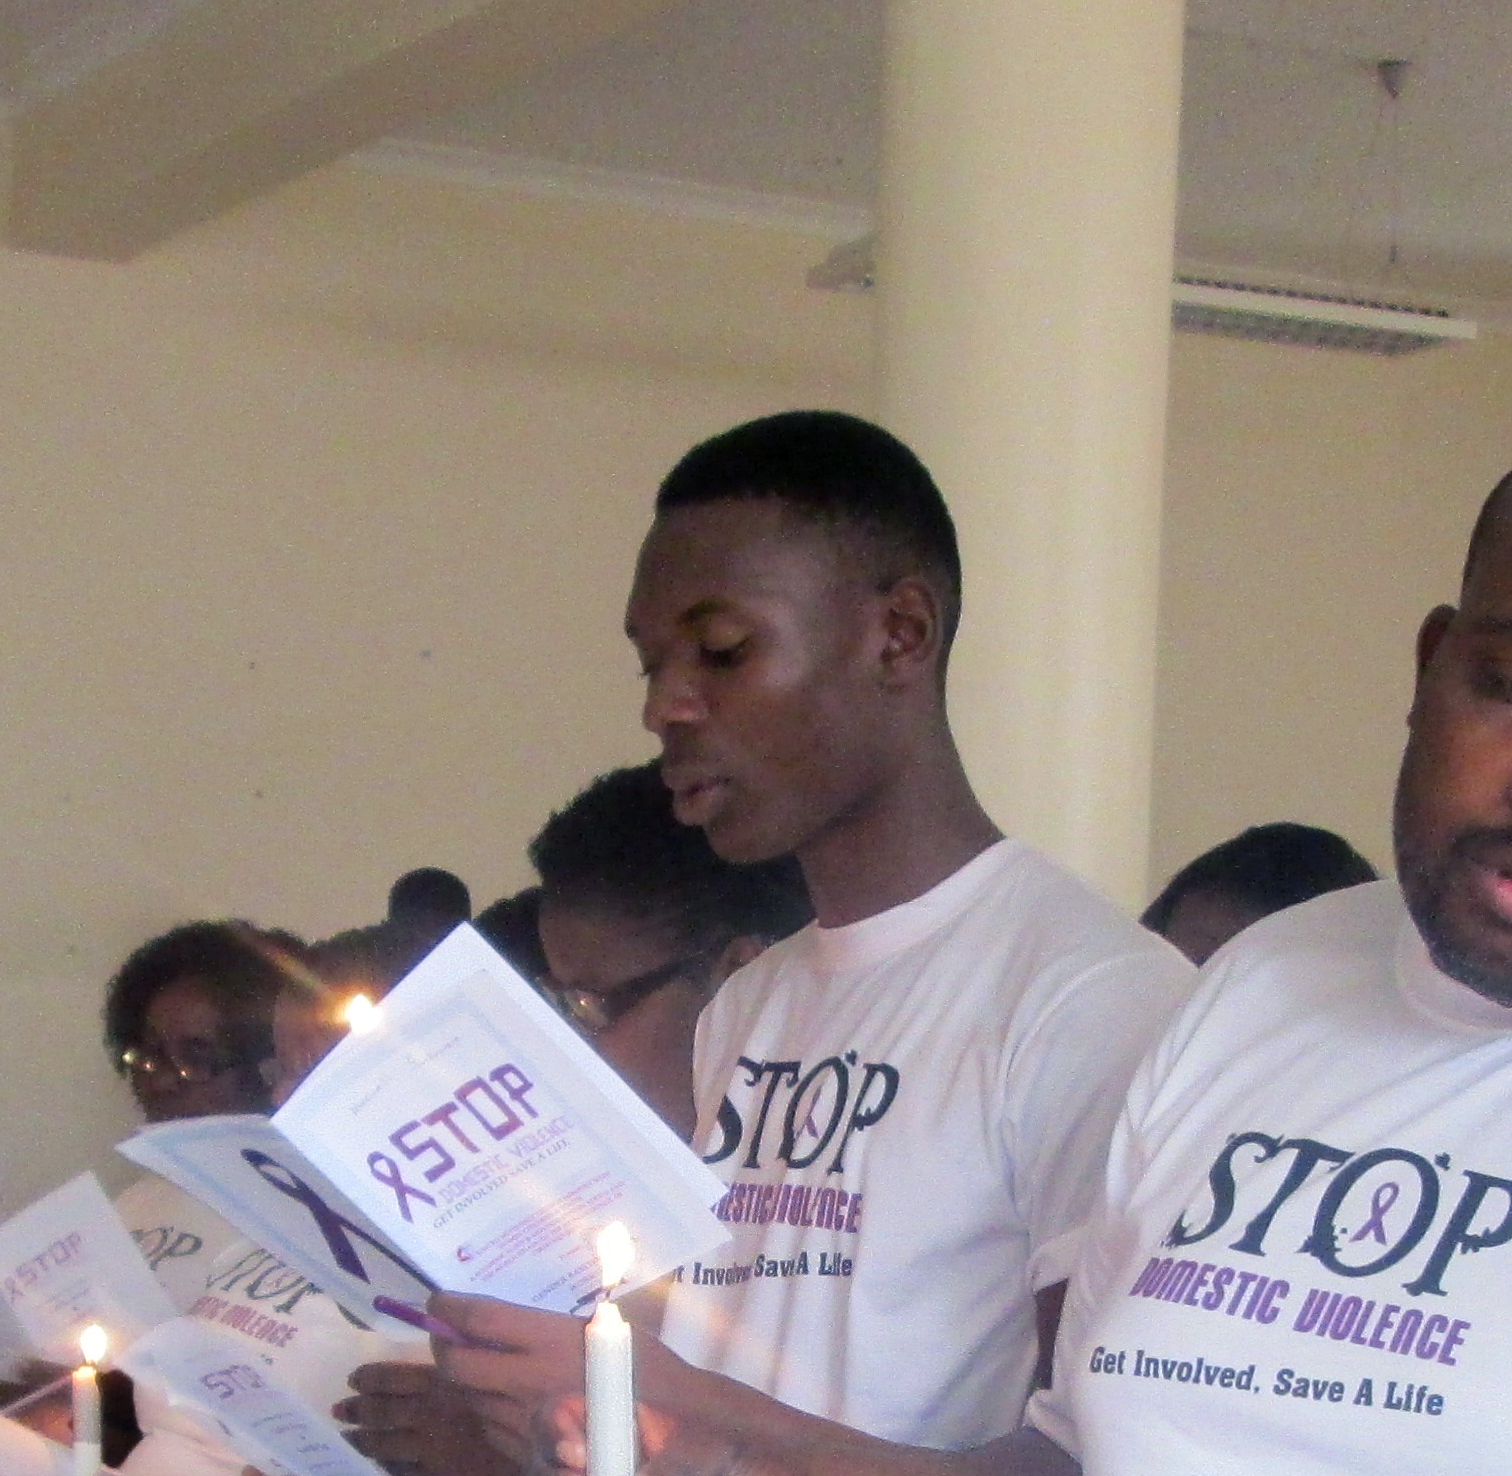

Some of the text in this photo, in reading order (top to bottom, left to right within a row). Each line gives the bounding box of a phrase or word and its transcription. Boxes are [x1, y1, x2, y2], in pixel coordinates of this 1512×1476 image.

[388, 1062, 539, 1183] STOP
[701, 1050, 900, 1176] STOP
[16, 1231, 83, 1287] STOP
[1129, 1257, 1472, 1367] DOMESTIC VIOLENCE
[1089, 1347, 1445, 1417] Get Involved, Save A Life
